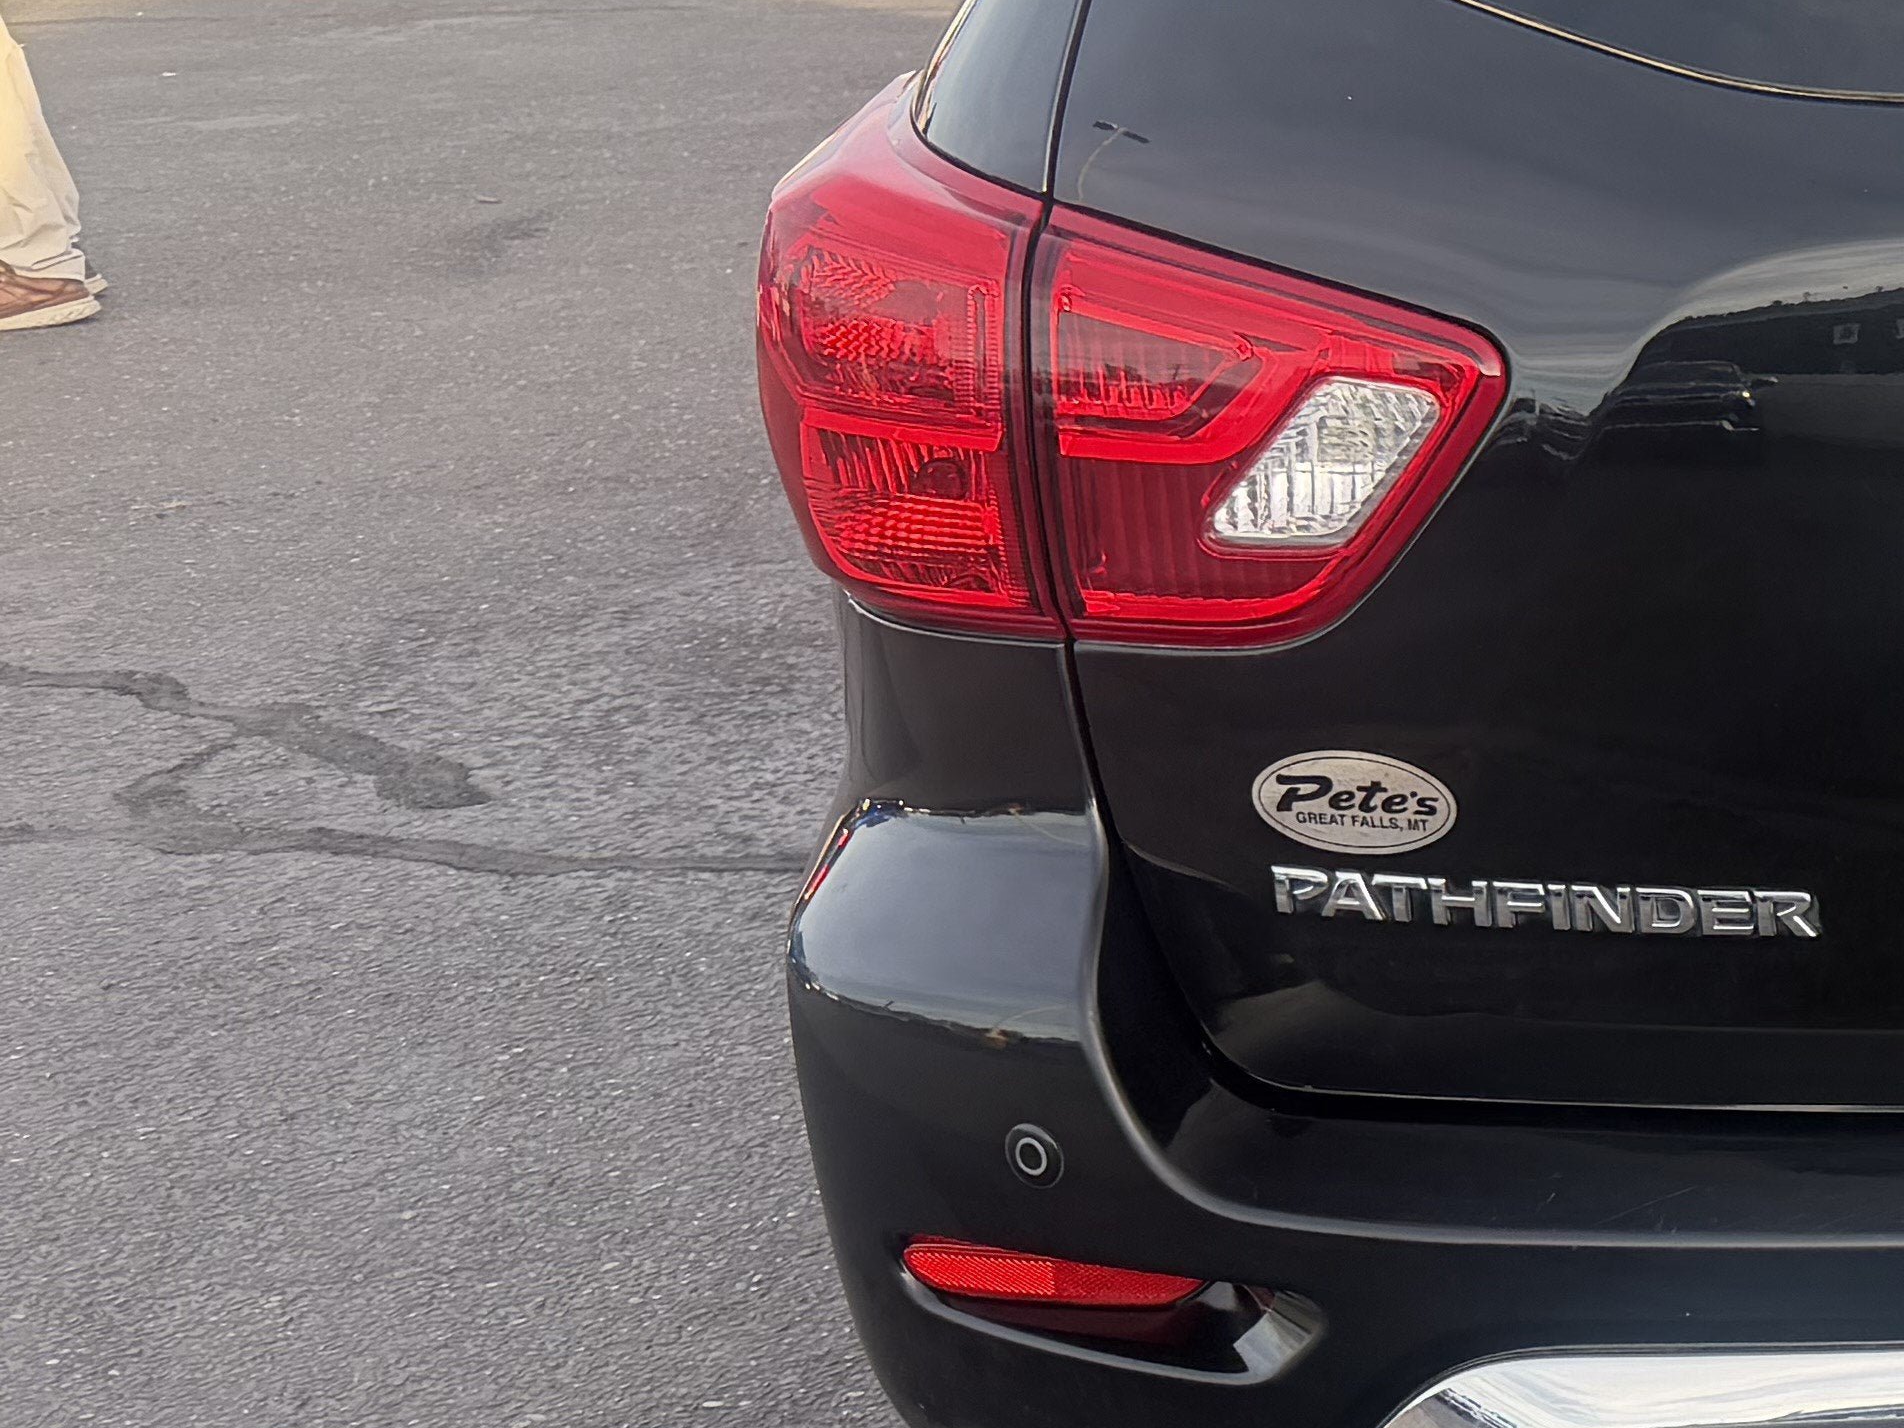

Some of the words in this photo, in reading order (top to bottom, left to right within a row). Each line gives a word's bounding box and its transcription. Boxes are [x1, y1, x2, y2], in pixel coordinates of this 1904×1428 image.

[1275, 773, 1440, 817] Pete's
[1296, 811, 1346, 827] GREAT
[1350, 814, 1404, 832] FALLS,
[1408, 819, 1429, 832] MT
[1270, 865, 1821, 938] PATHFINDER
